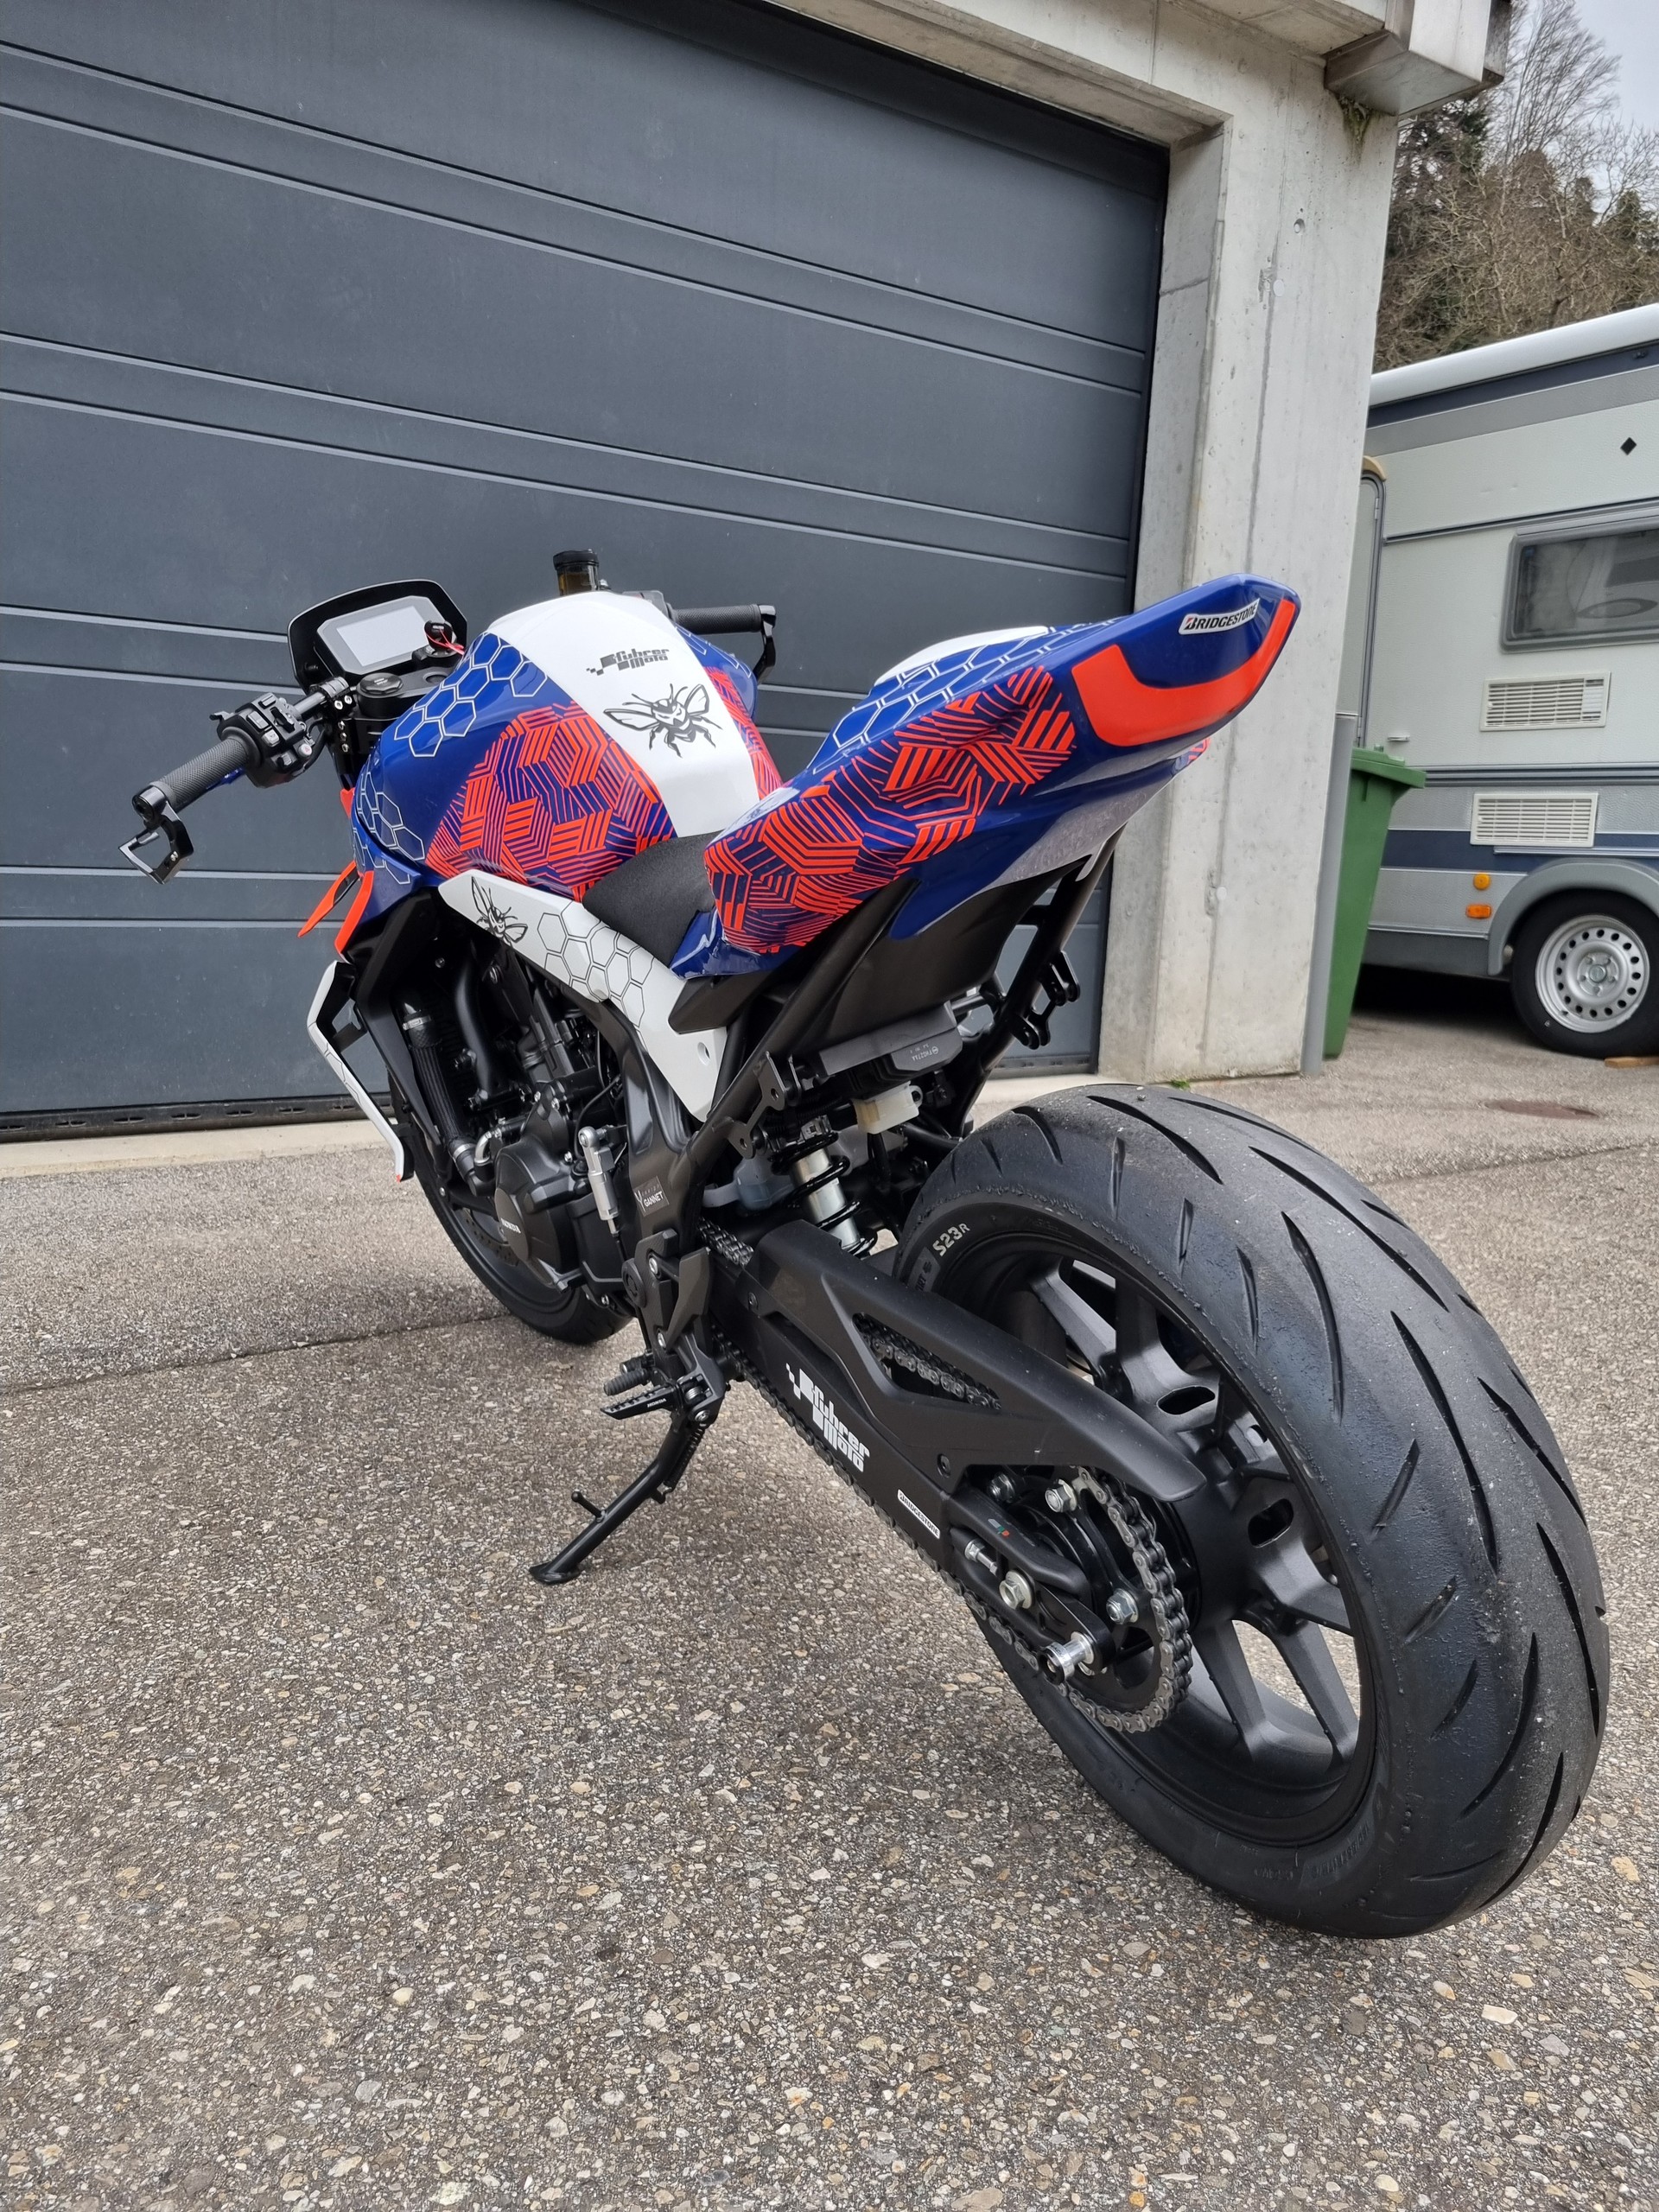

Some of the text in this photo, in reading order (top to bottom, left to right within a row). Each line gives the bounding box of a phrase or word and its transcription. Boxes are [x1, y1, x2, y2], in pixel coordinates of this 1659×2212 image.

[1183, 605, 1257, 630] BRIDGESTONE
[646, 1397, 667, 1408] HONDA
[899, 1492, 939, 1536] BRIDGESTONE
